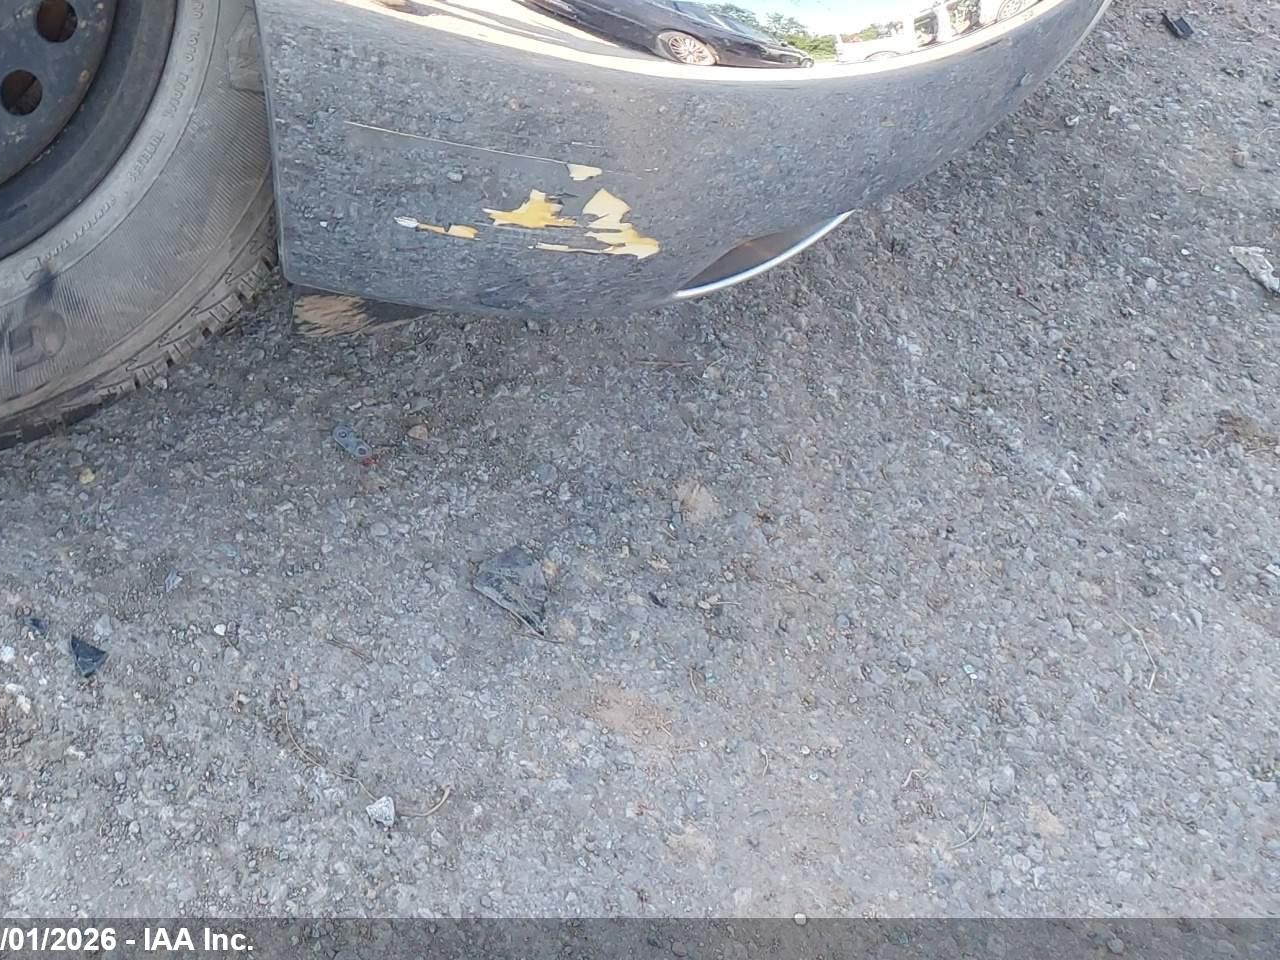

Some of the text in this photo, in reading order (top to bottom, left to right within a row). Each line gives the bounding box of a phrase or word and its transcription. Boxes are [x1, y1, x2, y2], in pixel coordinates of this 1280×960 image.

[184, 29, 202, 63] LOAD
[163, 72, 190, 121] RADIAL
[126, 129, 167, 184] TUBELESS
